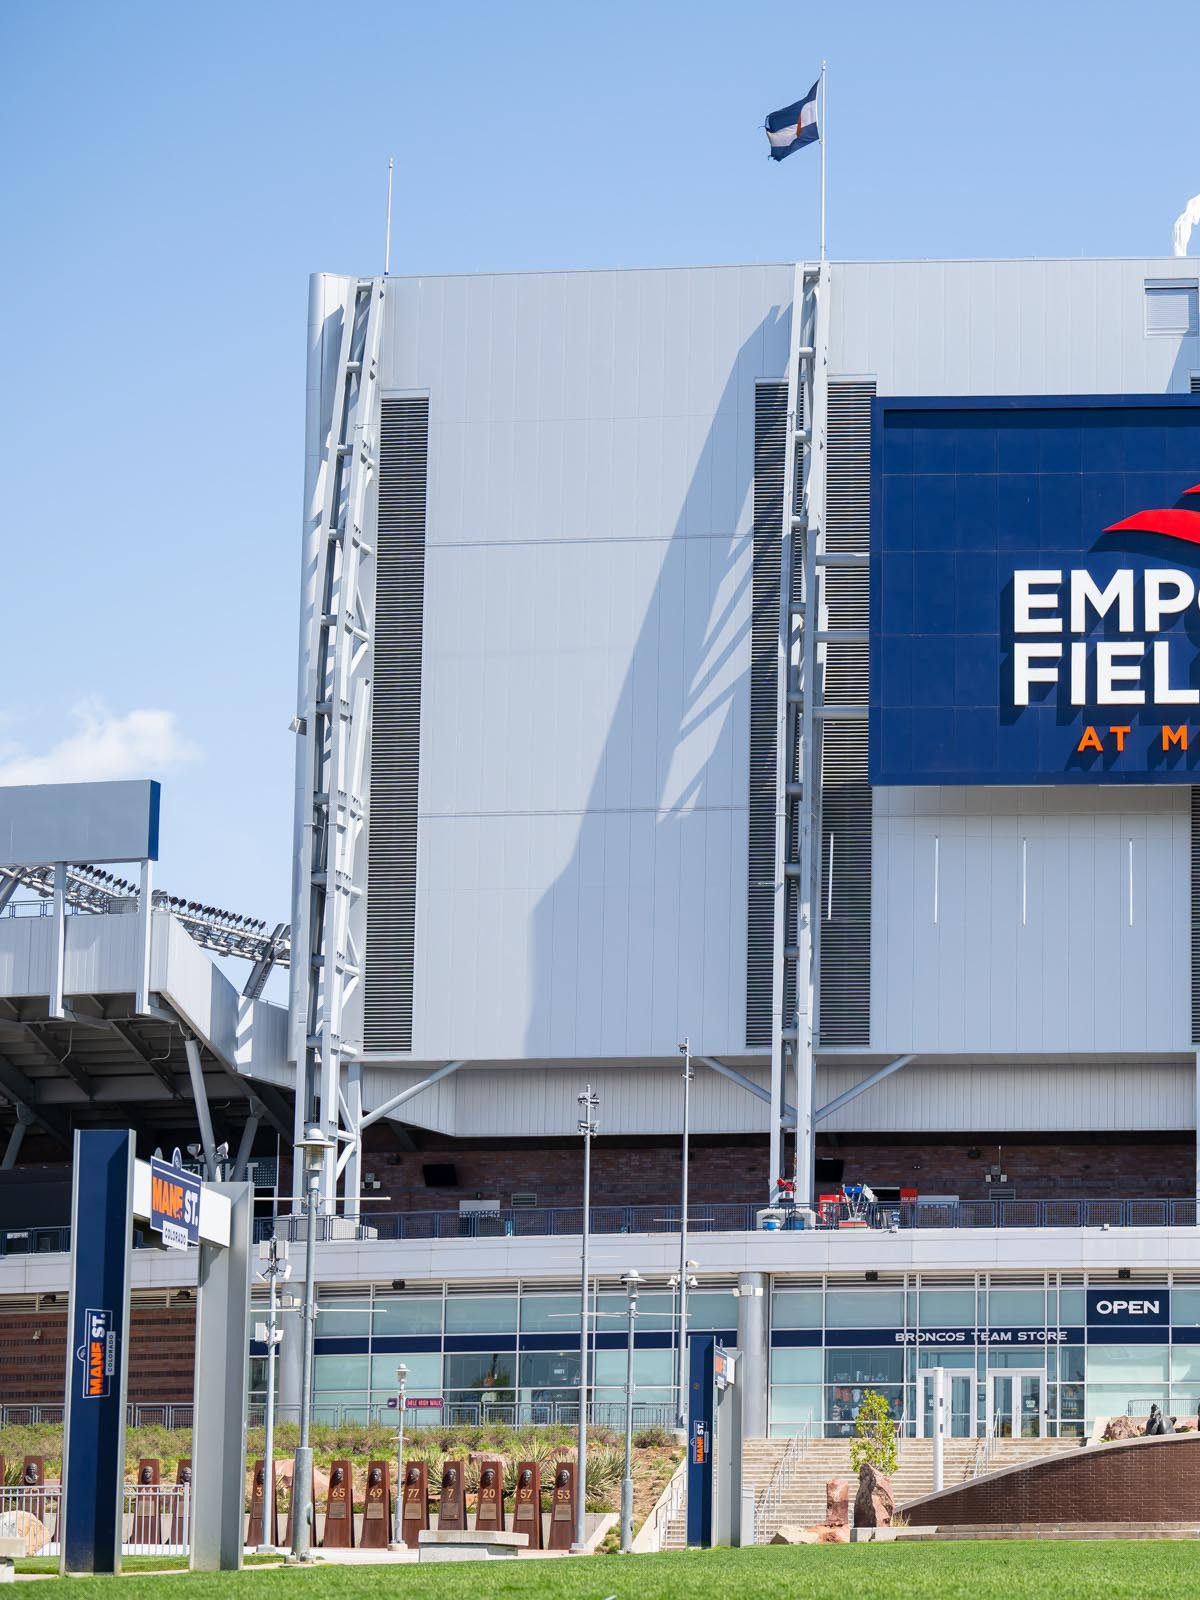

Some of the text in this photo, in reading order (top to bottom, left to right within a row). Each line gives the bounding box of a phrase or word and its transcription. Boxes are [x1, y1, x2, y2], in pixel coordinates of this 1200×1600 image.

[1076, 725, 1131, 752] AT
[152, 1175, 199, 1227] MANE ST.
[164, 1226, 187, 1246] COLORADO
[1095, 1300, 1160, 1315] OPEN
[895, 1330, 1068, 1342] BRONCOS TEAM STORE
[89, 1313, 106, 1395] MANE ST.
[696, 1436, 704, 1463] MANE
[331, 1488, 346, 1498] 65
[369, 1488, 383, 1498] 49
[407, 1488, 420, 1498] 77
[447, 1488, 454, 1498] 7
[482, 1488, 496, 1499] 20
[520, 1488, 533, 1499] 57
[557, 1489, 571, 1500] 53
